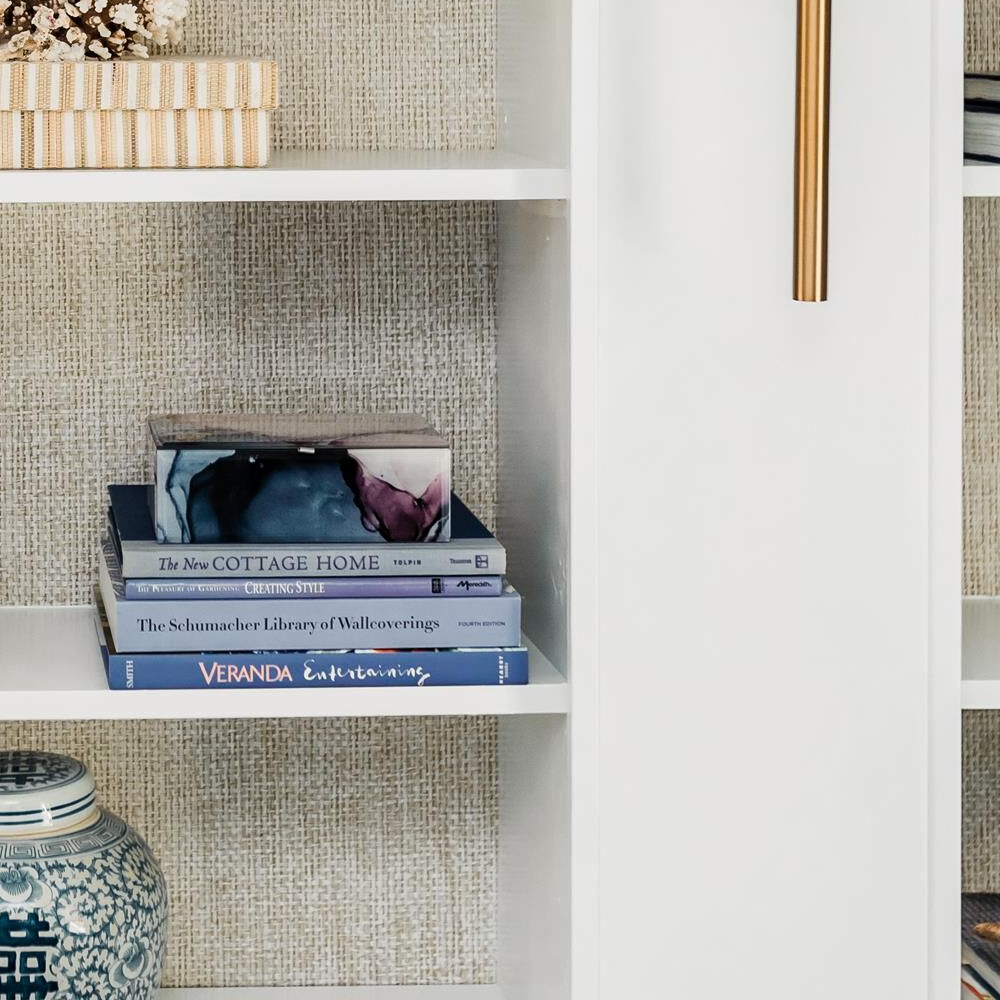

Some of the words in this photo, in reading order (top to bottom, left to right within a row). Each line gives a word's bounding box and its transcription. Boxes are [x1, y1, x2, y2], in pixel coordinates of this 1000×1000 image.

[159, 557, 179, 571] The
[182, 557, 210, 571] New
[212, 555, 308, 571] COTTAGE
[316, 555, 380, 571] HOME
[244, 581, 294, 595] CREATING
[295, 580, 326, 594] STYLE
[137, 618, 166, 632] The
[168, 617, 261, 632] Schumacher
[264, 617, 318, 635] Library
[320, 616, 336, 631] of
[337, 616, 440, 634] Wallcoverings
[126, 660, 134, 688] SMITH
[198, 661, 294, 686] VERANDA
[303, 658, 431, 686] Entertaining
